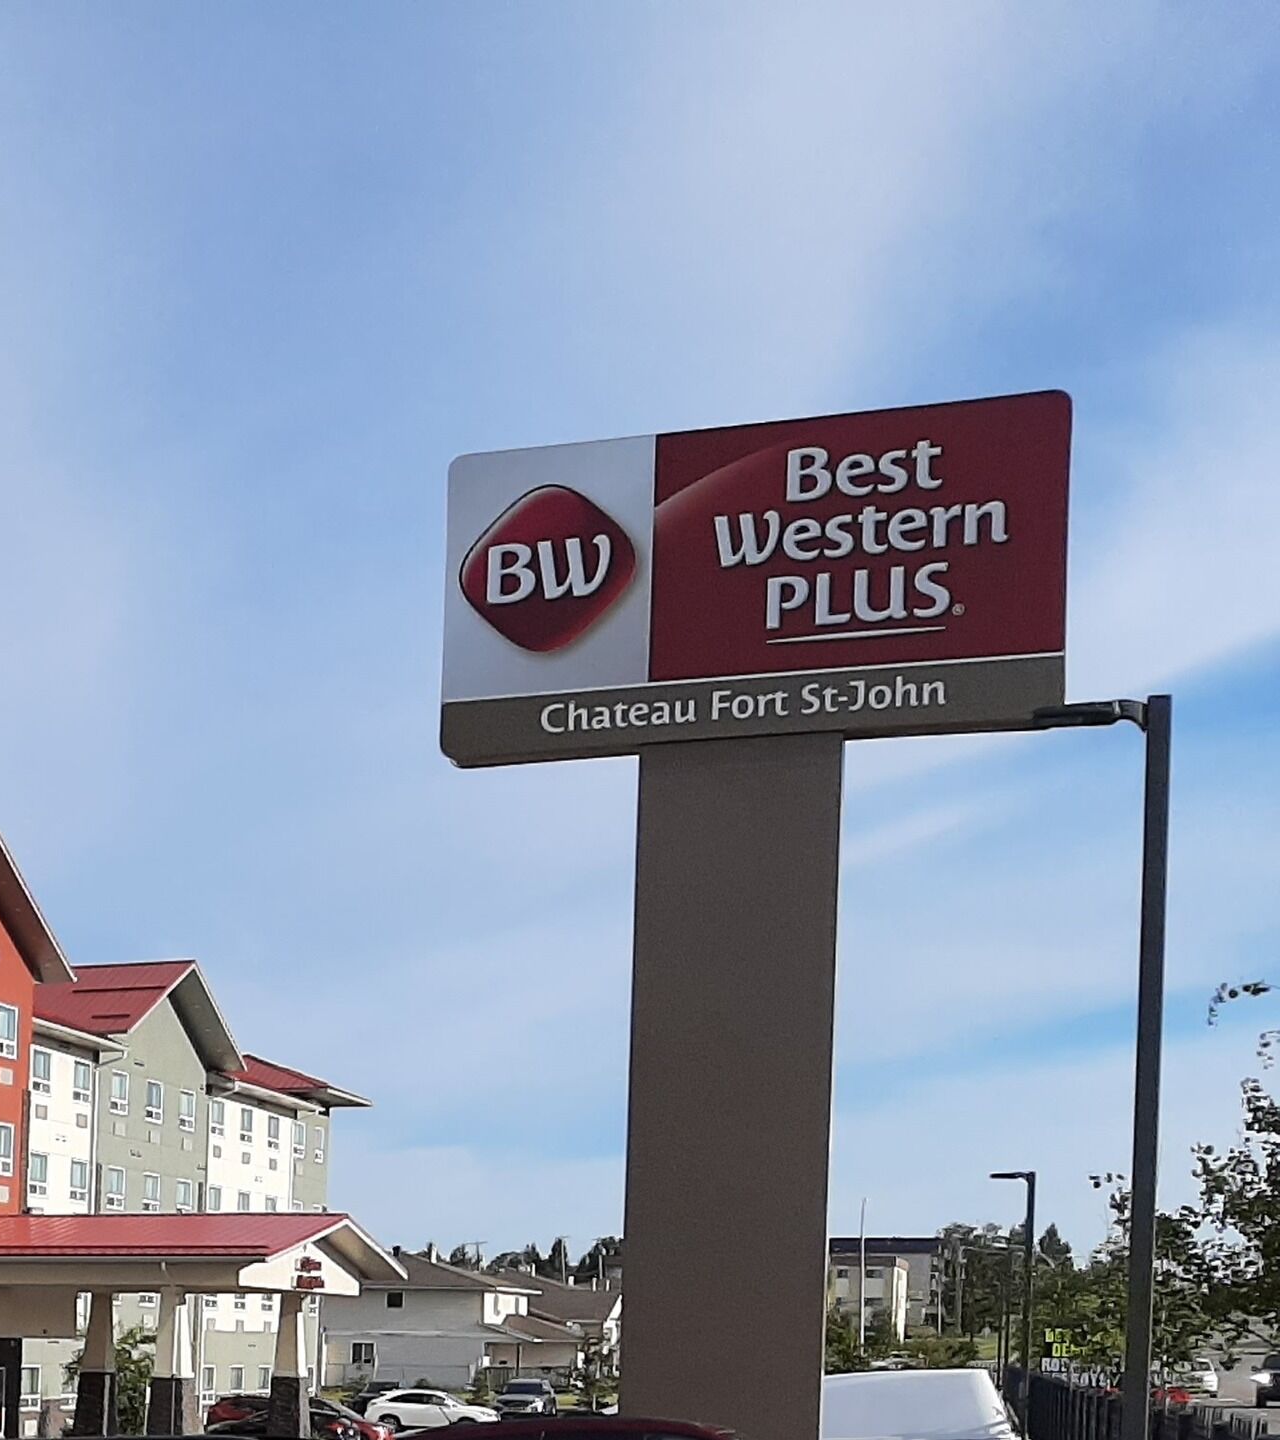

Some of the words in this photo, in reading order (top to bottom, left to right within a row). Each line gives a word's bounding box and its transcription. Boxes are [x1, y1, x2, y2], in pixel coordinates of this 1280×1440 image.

[785, 439, 943, 503] Best
[713, 500, 1009, 568] Western
[486, 532, 612, 605] BW
[540, 696, 697, 735] Chateau
[711, 687, 789, 721] Fort
[800, 676, 947, 715] St-John
